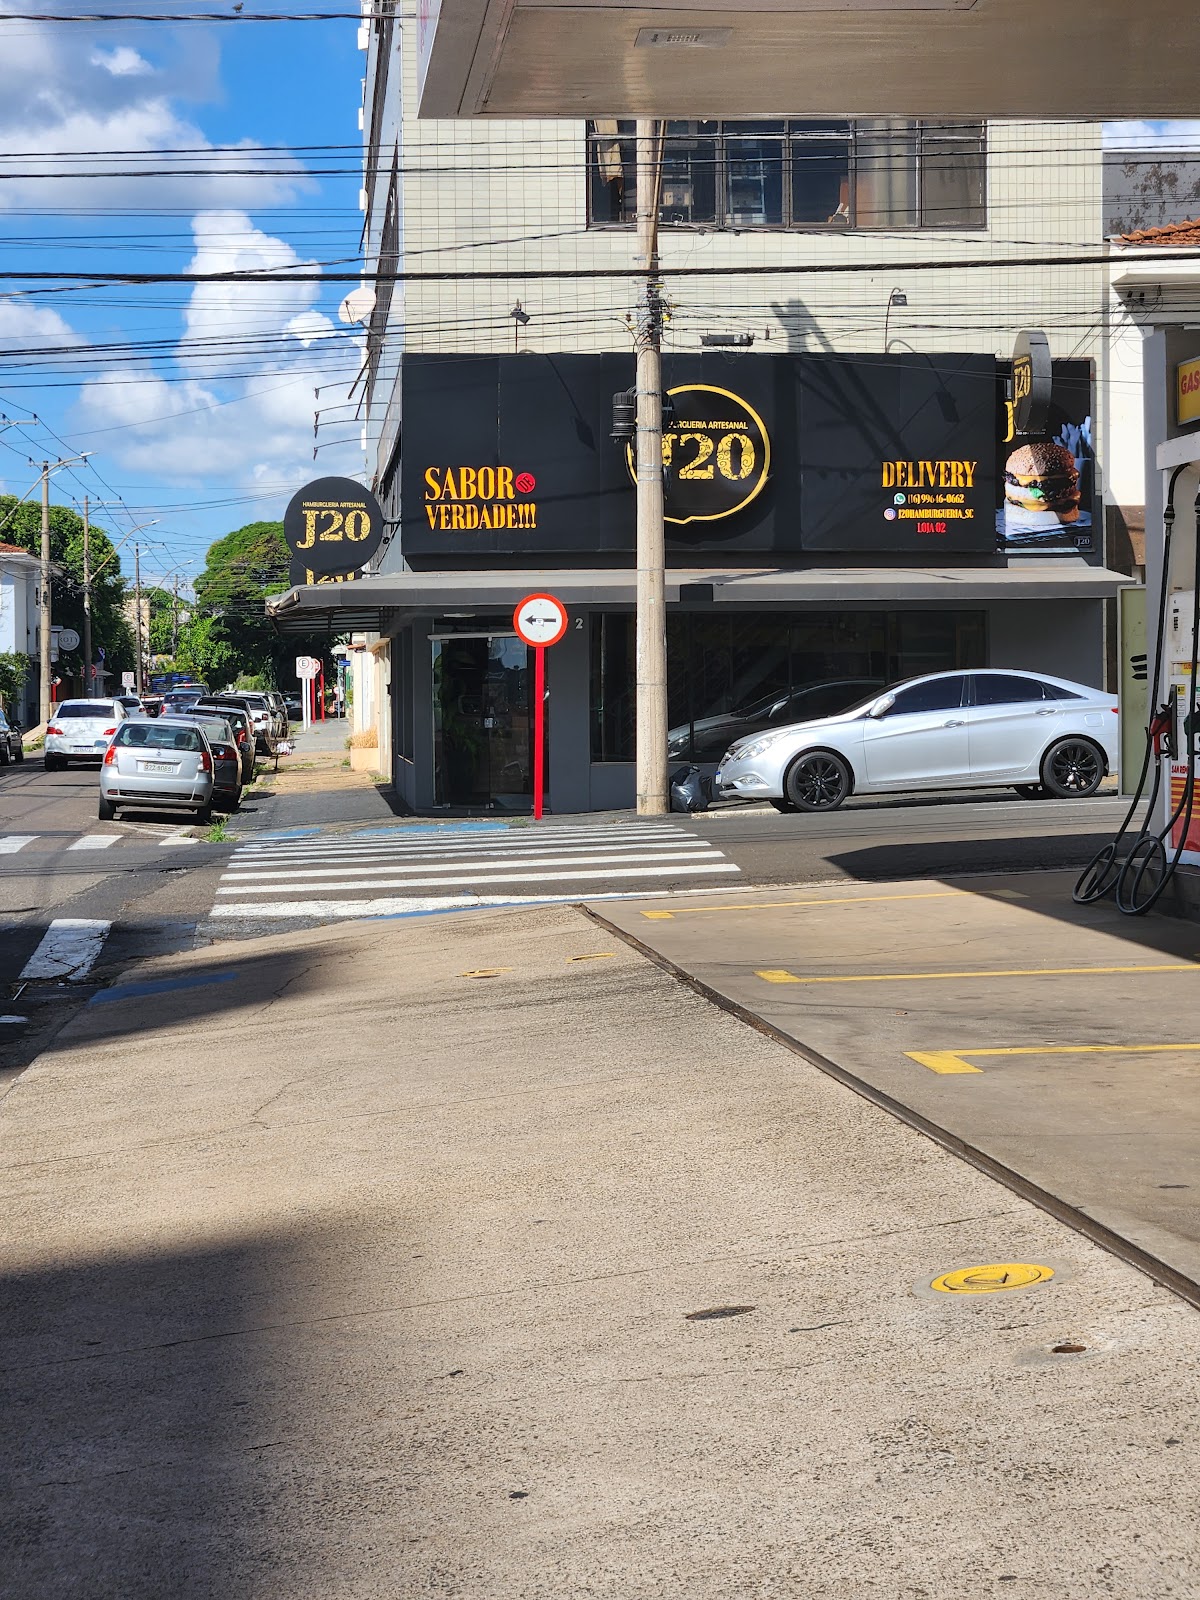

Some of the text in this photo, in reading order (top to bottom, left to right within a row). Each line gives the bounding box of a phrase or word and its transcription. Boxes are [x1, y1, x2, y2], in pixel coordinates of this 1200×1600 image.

[708, 421, 749, 430] ARTESANAL
[881, 461, 978, 488] DELIVERY
[424, 466, 534, 500] SABOR DE
[340, 501, 367, 509] ARTESANAL
[425, 503, 537, 530] VERDADE!!!
[296, 510, 371, 549] J20
[917, 522, 947, 533] LOJA 02
[1077, 538, 1091, 547] J20
[575, 617, 584, 630] 2
